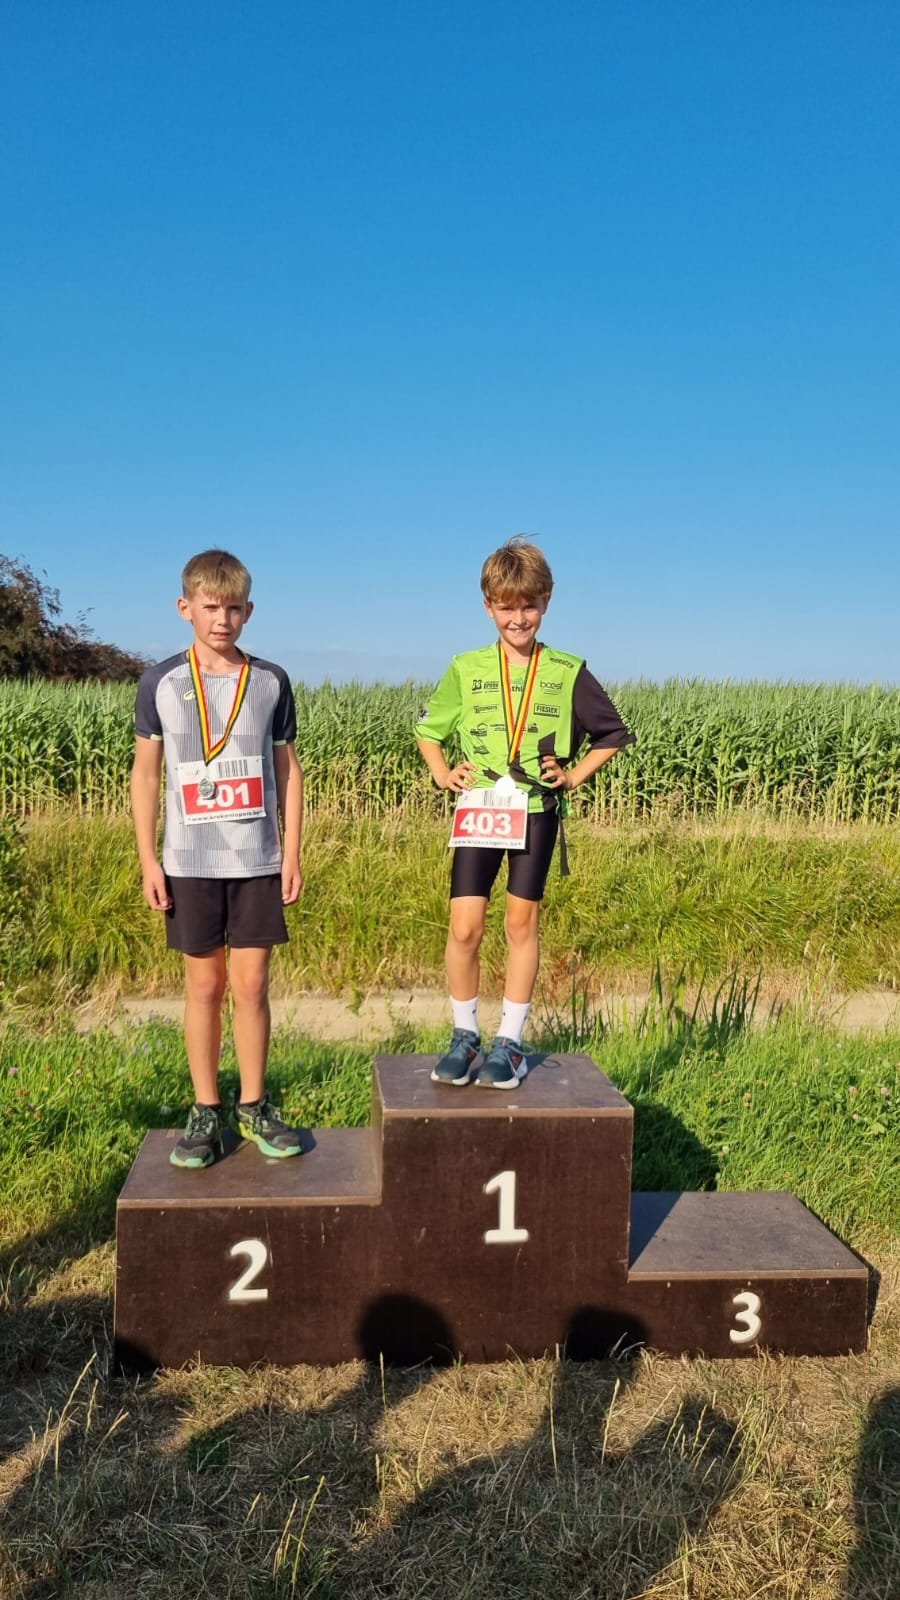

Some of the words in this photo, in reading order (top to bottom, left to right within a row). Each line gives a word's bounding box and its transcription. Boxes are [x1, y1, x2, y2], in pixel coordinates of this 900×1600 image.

[459, 811, 512, 836] 403
[485, 1170, 529, 1244] 1
[229, 1239, 268, 1301] 2
[729, 1291, 762, 1344] 3
